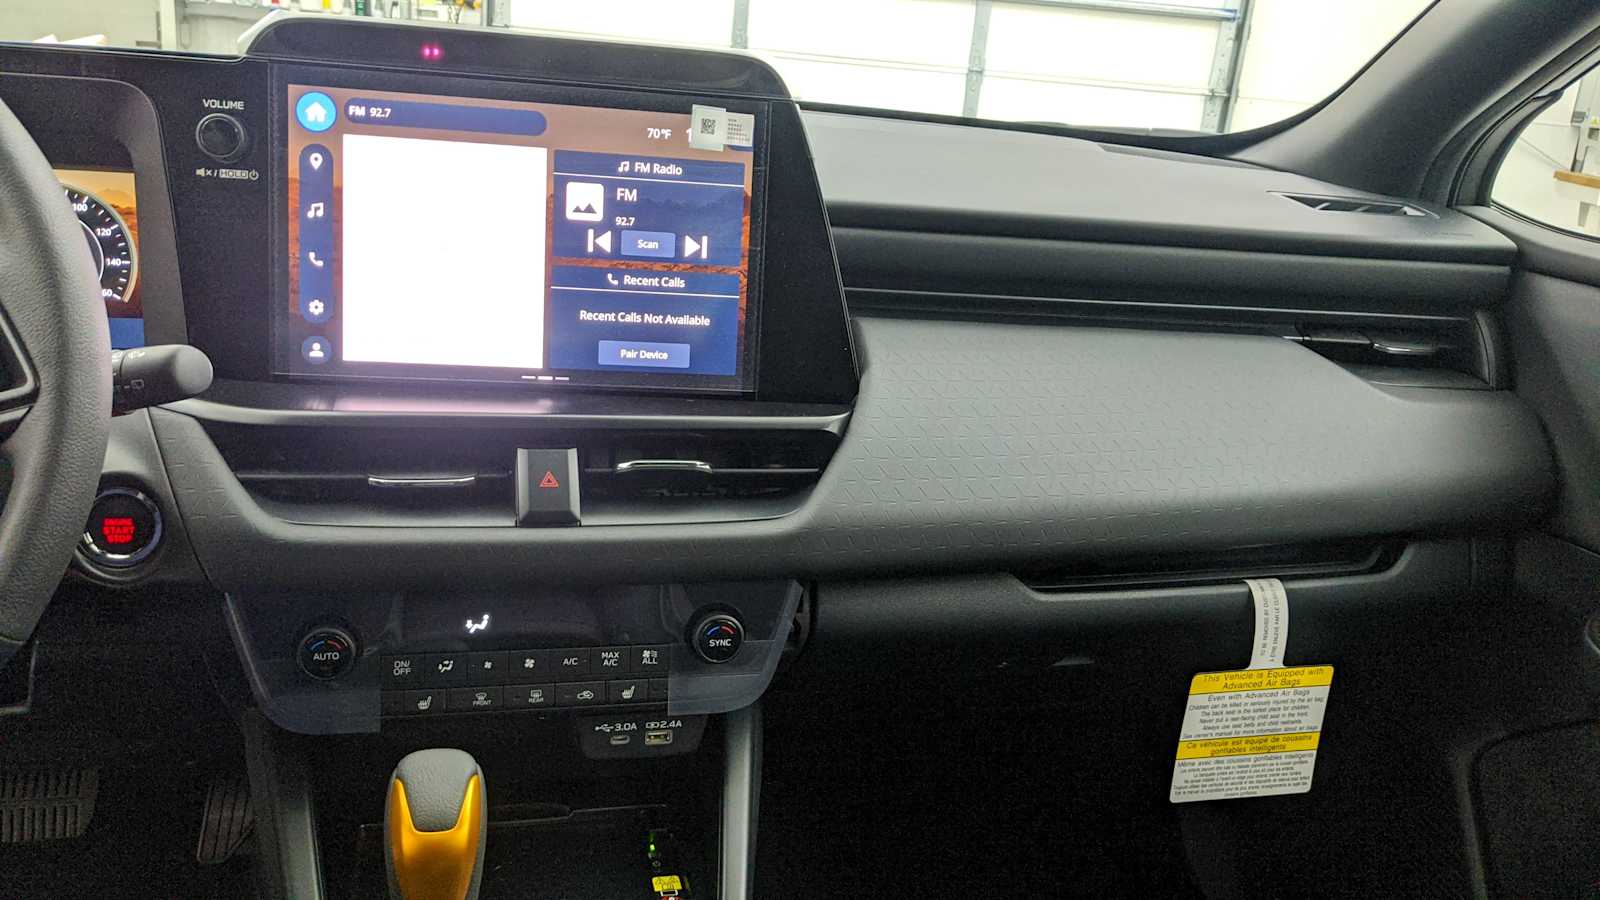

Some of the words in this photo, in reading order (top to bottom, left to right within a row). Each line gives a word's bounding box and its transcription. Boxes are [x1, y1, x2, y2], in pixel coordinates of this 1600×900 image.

[202, 99, 245, 110] VOLUME
[348, 105, 366, 117] FM
[370, 107, 392, 118] 92.7
[647, 127, 673, 139] 70°F
[634, 162, 651, 174] FM
[653, 164, 683, 176] Radio
[616, 188, 638, 202] FM
[73, 203, 88, 212] 100
[615, 217, 636, 227] 92.7
[96, 228, 112, 237] 120
[637, 239, 659, 249] Scan
[106, 258, 121, 266] 140
[623, 275, 660, 287] Recent
[661, 277, 686, 289] Calls
[101, 289, 113, 297] 60
[580, 310, 616, 322] Recent
[617, 312, 642, 323] Calls
[644, 314, 663, 325] Not
[664, 314, 711, 327] Available
[620, 349, 638, 359] Pair
[639, 350, 669, 360] Device
[709, 639, 732, 647] SYNC
[313, 652, 340, 661] AUTO
[601, 652, 619, 660] MAX
[394, 660, 410, 669] ON/
[563, 658, 578, 666] A/C
[603, 659, 618, 667] A/C
[393, 667, 411, 676] OFF
[1203, 674, 1220, 682] This
[1224, 671, 1254, 680] Vehicle
[1267, 669, 1305, 680] Equipped
[1308, 668, 1324, 676] with
[1222, 680, 1263, 689] Advanced
[1266, 679, 1277, 687] Air
[1280, 678, 1301, 688] Bags
[1207, 694, 1226, 702] Even
[1245, 691, 1279, 700] Advanced
[1293, 689, 1310, 697] Bags
[472, 699, 492, 707] FRONT
[614, 722, 637, 732] 3.0A
[660, 720, 682, 729] 2.4A
